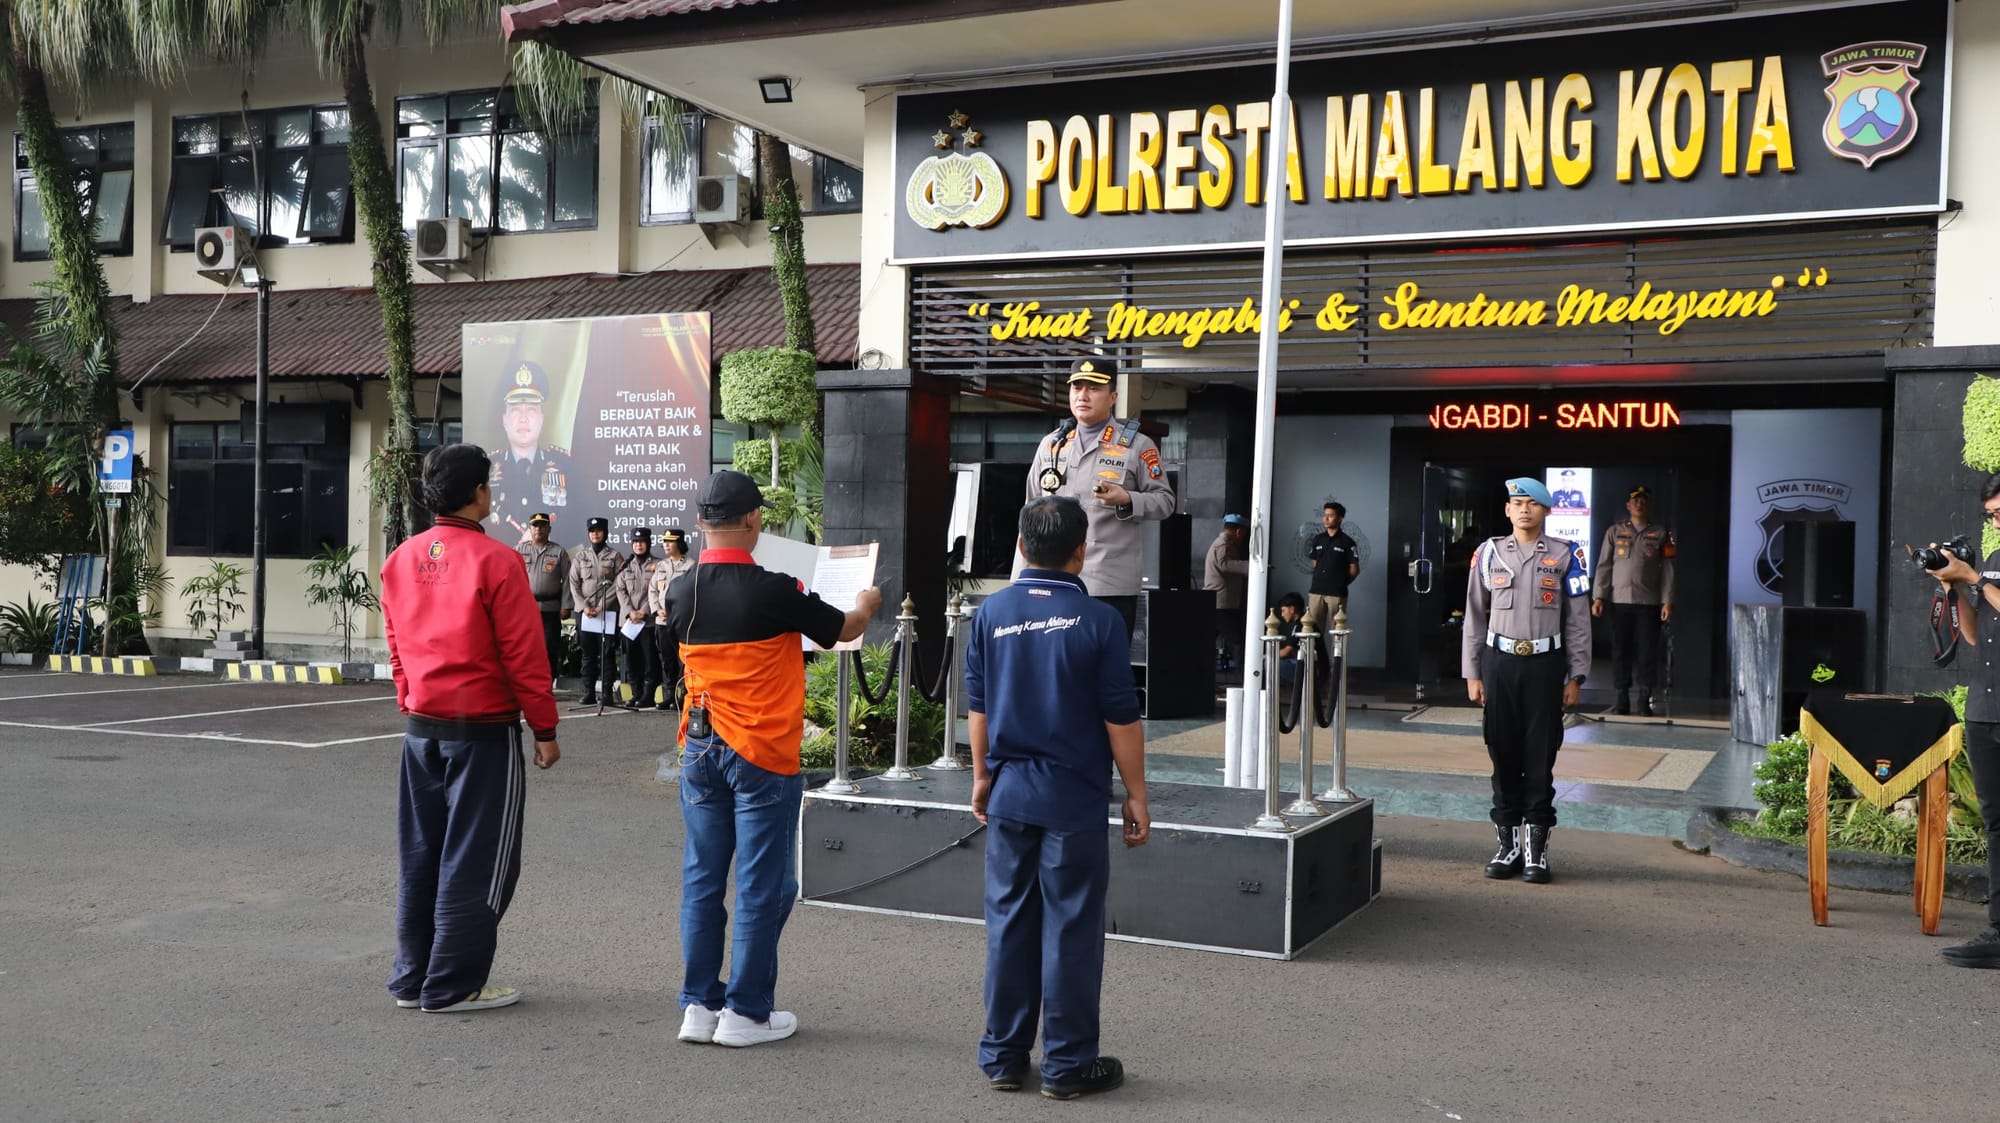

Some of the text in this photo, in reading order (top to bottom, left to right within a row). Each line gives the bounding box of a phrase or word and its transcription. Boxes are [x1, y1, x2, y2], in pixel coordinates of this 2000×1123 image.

[1831, 47, 1917, 66] JAWA TIMUR
[1325, 73, 1593, 201] MALANG
[1616, 56, 1795, 183] KOTA
[1106, 297, 1300, 348] Mengabi
[1316, 292, 1359, 331] &
[1384, 282, 1546, 331] Santun
[616, 389, 675, 403] “Teruslah
[600, 406, 697, 421] BERBUAT BAIK
[1556, 402, 1680, 428] SANTUN
[594, 424, 703, 438] BERKATA BAIK &
[103, 435, 129, 474] P
[615, 443, 681, 456] HATI BAIK
[609, 460, 686, 474] karena akan
[1099, 458, 1125, 468] POLRI
[598, 478, 698, 491] DIKENANG oleh
[1764, 483, 1845, 497] JAWA TIMUR
[608, 498, 687, 511] orang-orang
[614, 514, 680, 529] yang akan
[605, 532, 620, 543] ta
[1023, 620, 1047, 631] Kamu
